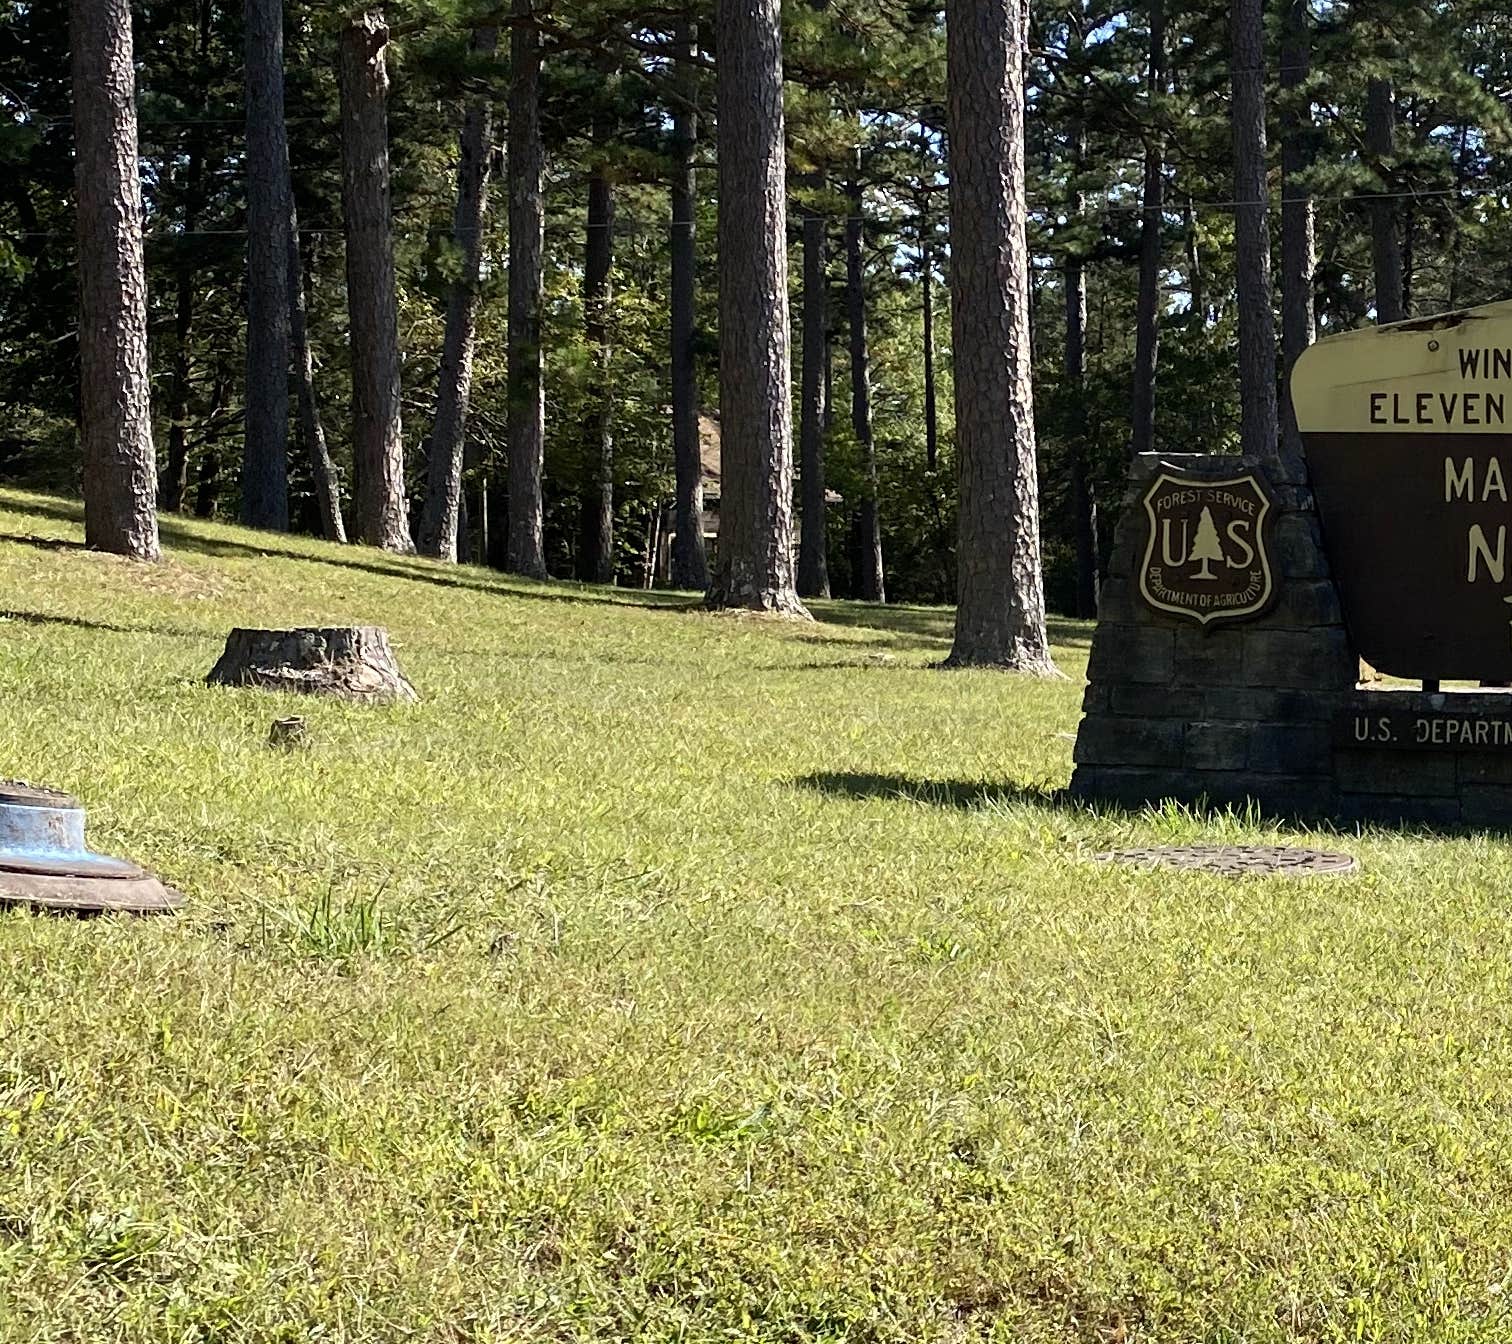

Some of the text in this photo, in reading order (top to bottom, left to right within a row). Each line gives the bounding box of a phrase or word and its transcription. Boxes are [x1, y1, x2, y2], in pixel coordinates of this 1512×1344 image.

[1369, 393, 1505, 426] ELEVEN
[1157, 489, 1255, 516] FOREST SERVICE
[1150, 567, 1261, 606] DEPARTMENT OF AGRICULTURE
[1355, 717, 1398, 743] U.S.
